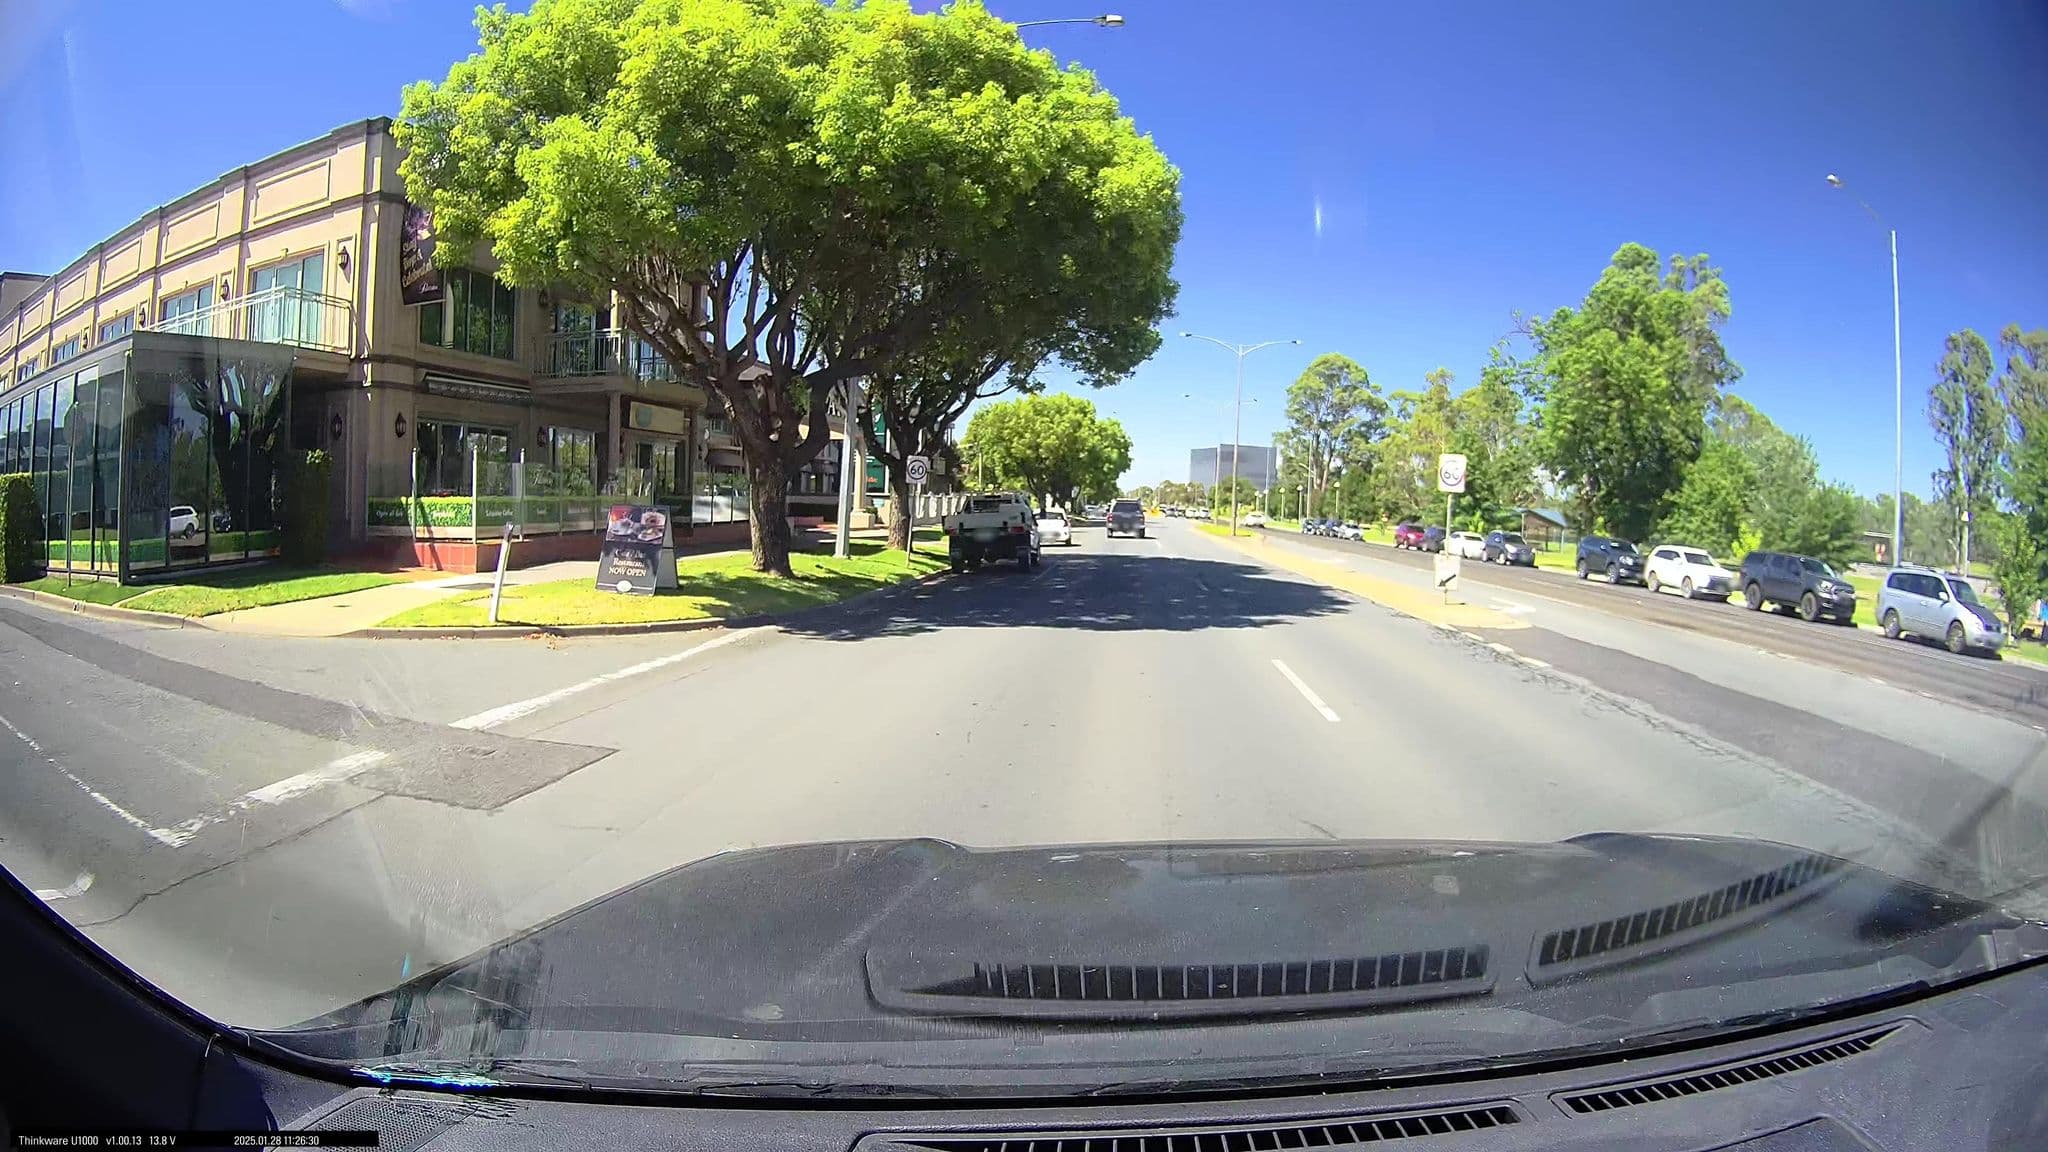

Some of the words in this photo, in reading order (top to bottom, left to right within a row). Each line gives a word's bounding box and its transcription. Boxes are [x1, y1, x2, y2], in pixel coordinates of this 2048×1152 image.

[911, 465, 924, 475] 60
[608, 566, 626, 575] NOW
[627, 568, 647, 576] OPEN
